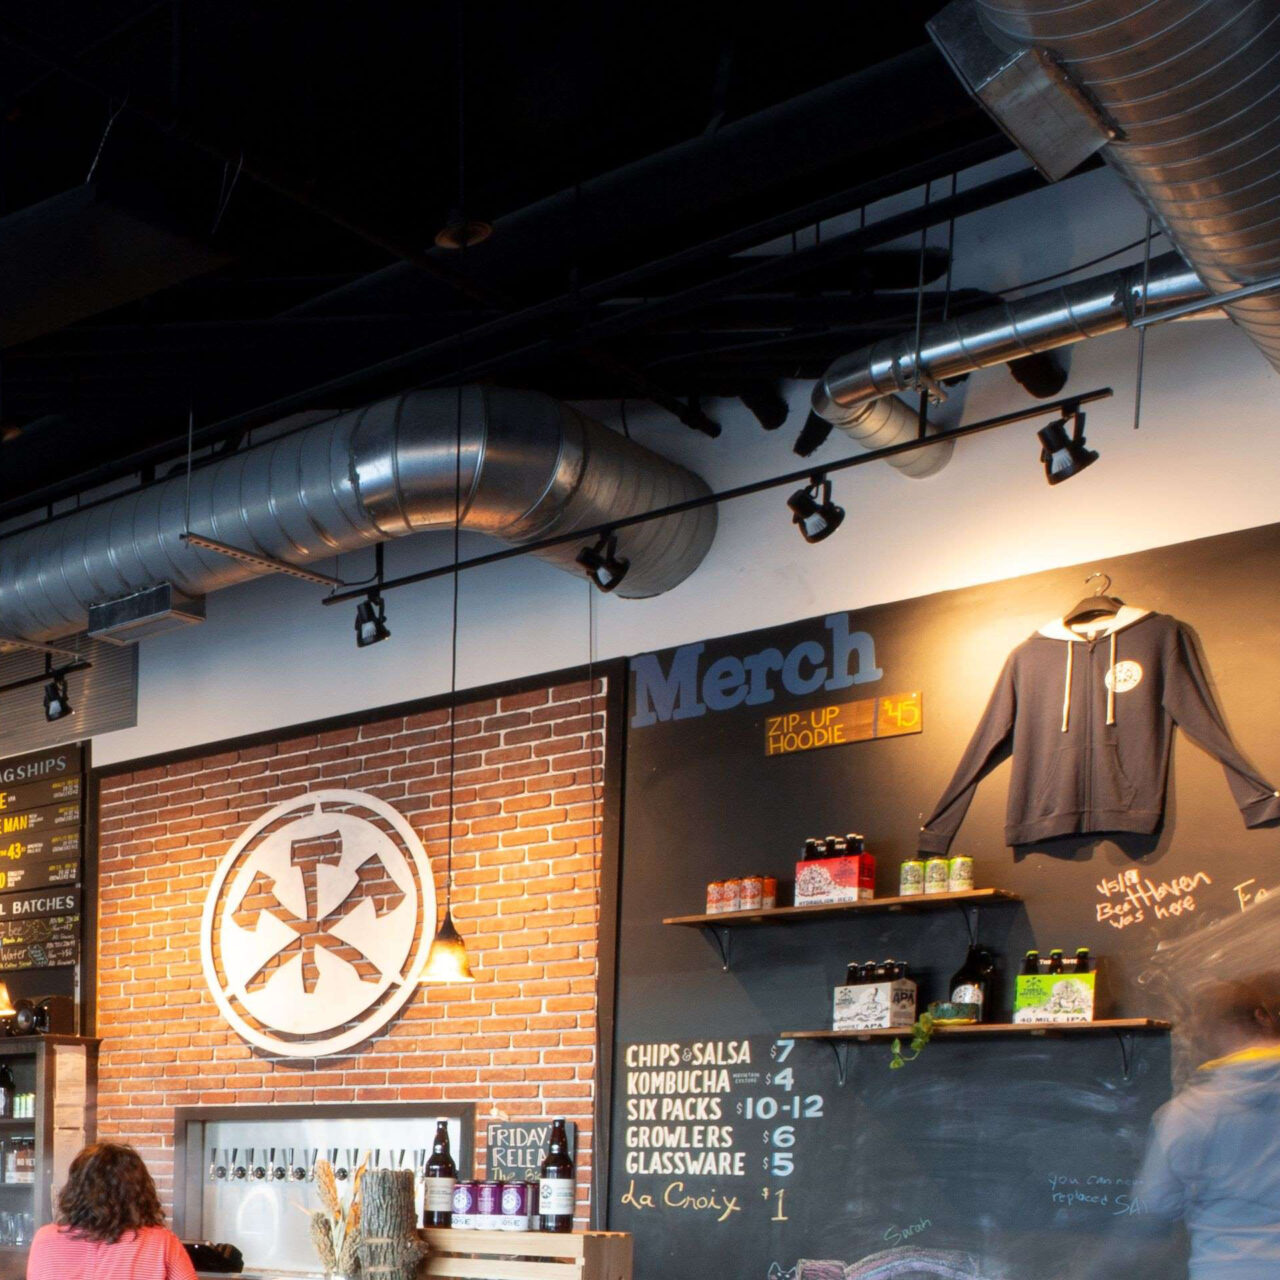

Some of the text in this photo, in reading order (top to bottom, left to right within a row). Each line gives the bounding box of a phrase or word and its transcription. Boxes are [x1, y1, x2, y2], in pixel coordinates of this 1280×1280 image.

[631, 613, 883, 728] Merch
[768, 701, 919, 736] ZIP-UP $45
[770, 725, 846, 754] HOODIE
[3, 815, 28, 833] MAN
[13, 896, 74, 914] BATCHES
[1154, 896, 1196, 919] here
[626, 1039, 795, 1067] CHIPS & SALSA $7
[627, 1069, 731, 1095] KOMBUCHA
[765, 1067, 794, 1091] $4
[626, 1098, 658, 1121] SIX
[661, 1097, 722, 1121] PACKS
[626, 1125, 796, 1148] GROWLERS $6
[492, 1168, 516, 1181] The
[626, 1151, 795, 1177] GLASSWARE $5
[1048, 1175, 1079, 1191] you
[621, 1180, 789, 1222] La Croix $1
[883, 1217, 933, 1246] Sarah
